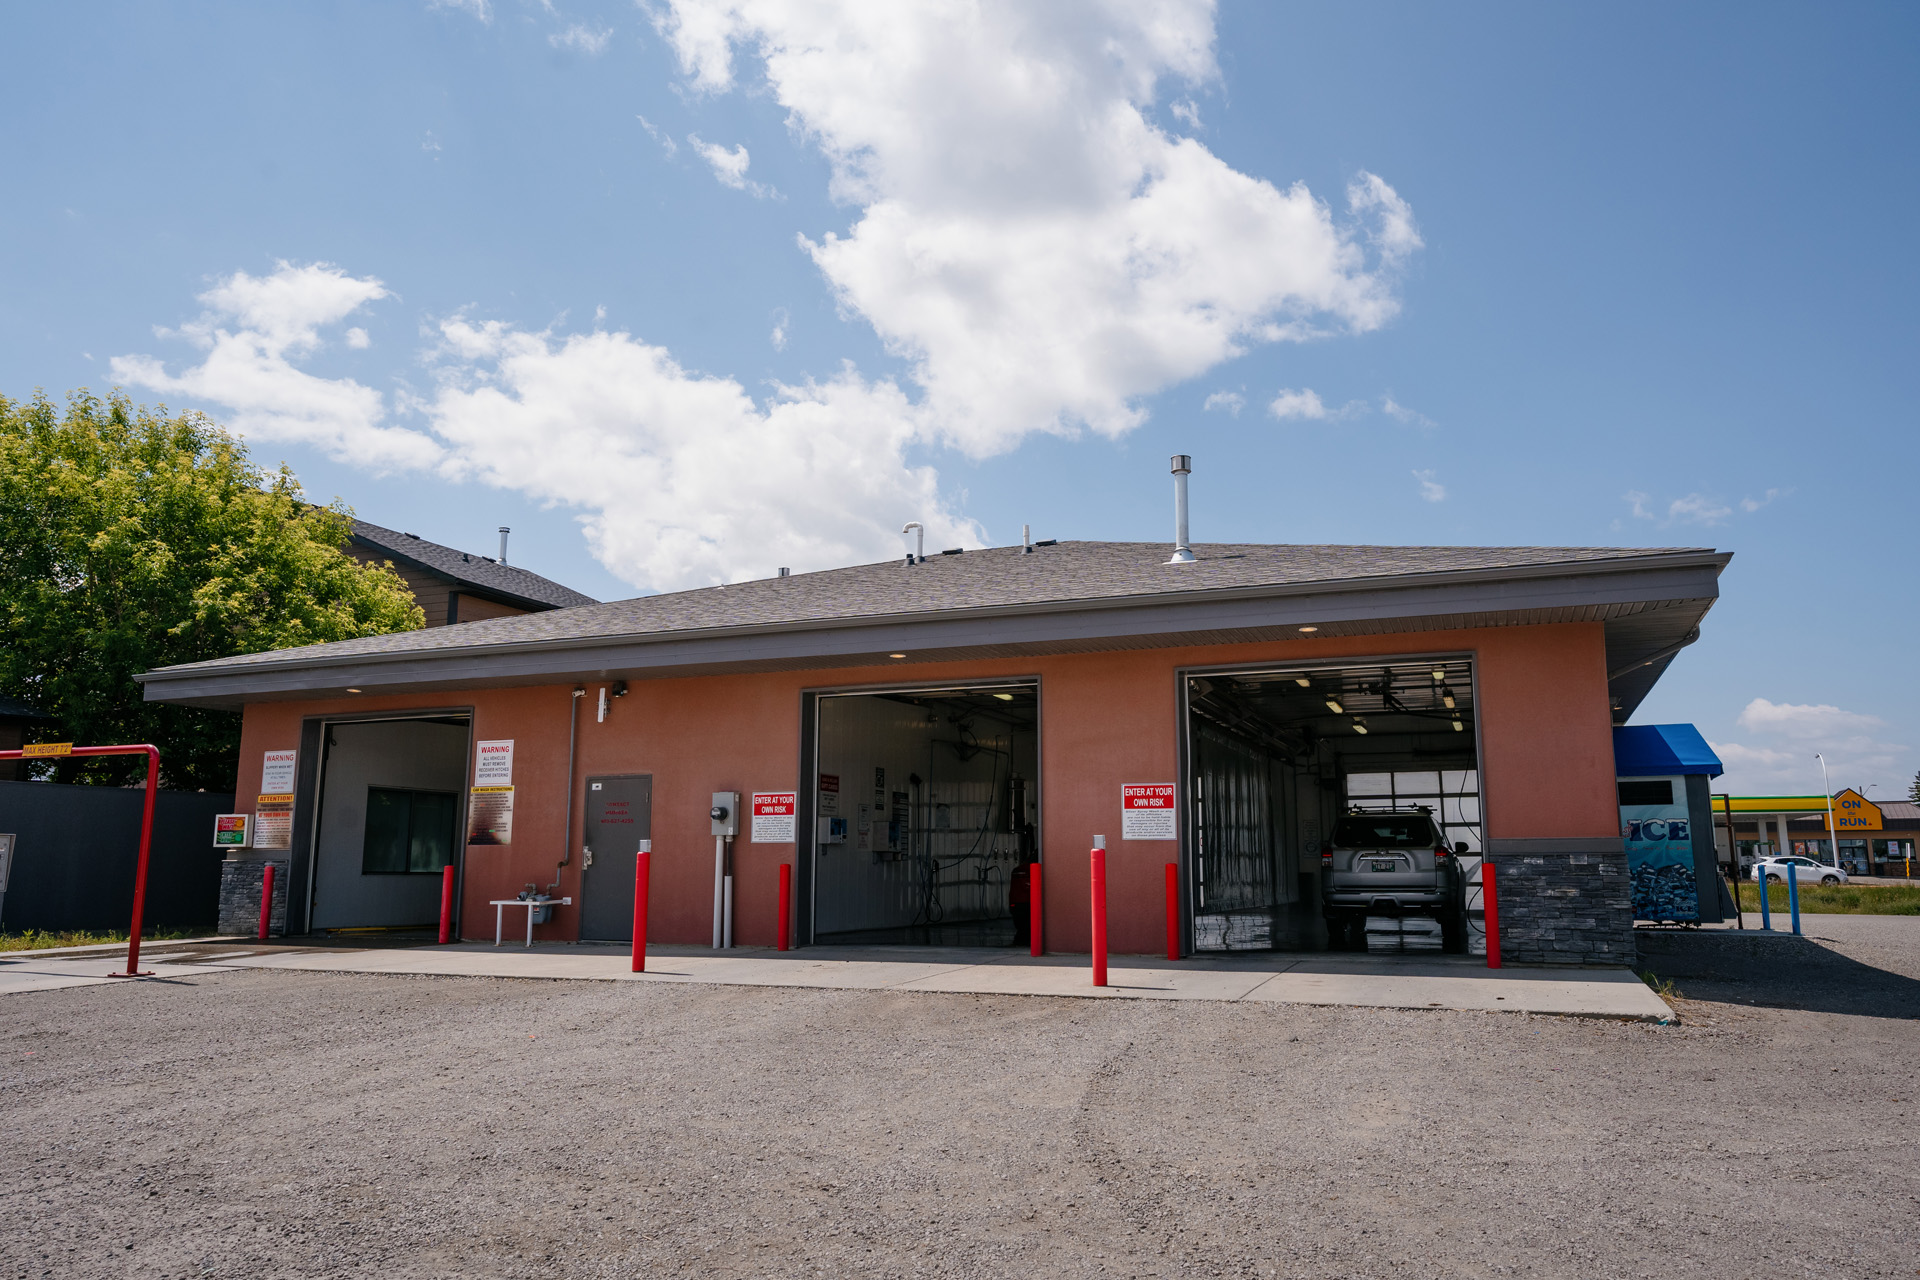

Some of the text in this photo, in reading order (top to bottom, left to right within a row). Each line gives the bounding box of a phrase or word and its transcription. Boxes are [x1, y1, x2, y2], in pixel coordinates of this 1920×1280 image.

[24, 746, 36, 754] MAX
[38, 745, 59, 754] HEIGHT
[1125, 788, 1145, 796] ENTER
[1155, 787, 1173, 796] YOUR
[1133, 798, 1164, 807] OWN RISK
[1842, 800, 1861, 809] ON
[1839, 818, 1867, 826] RUN
[1627, 818, 1690, 841] ICE
